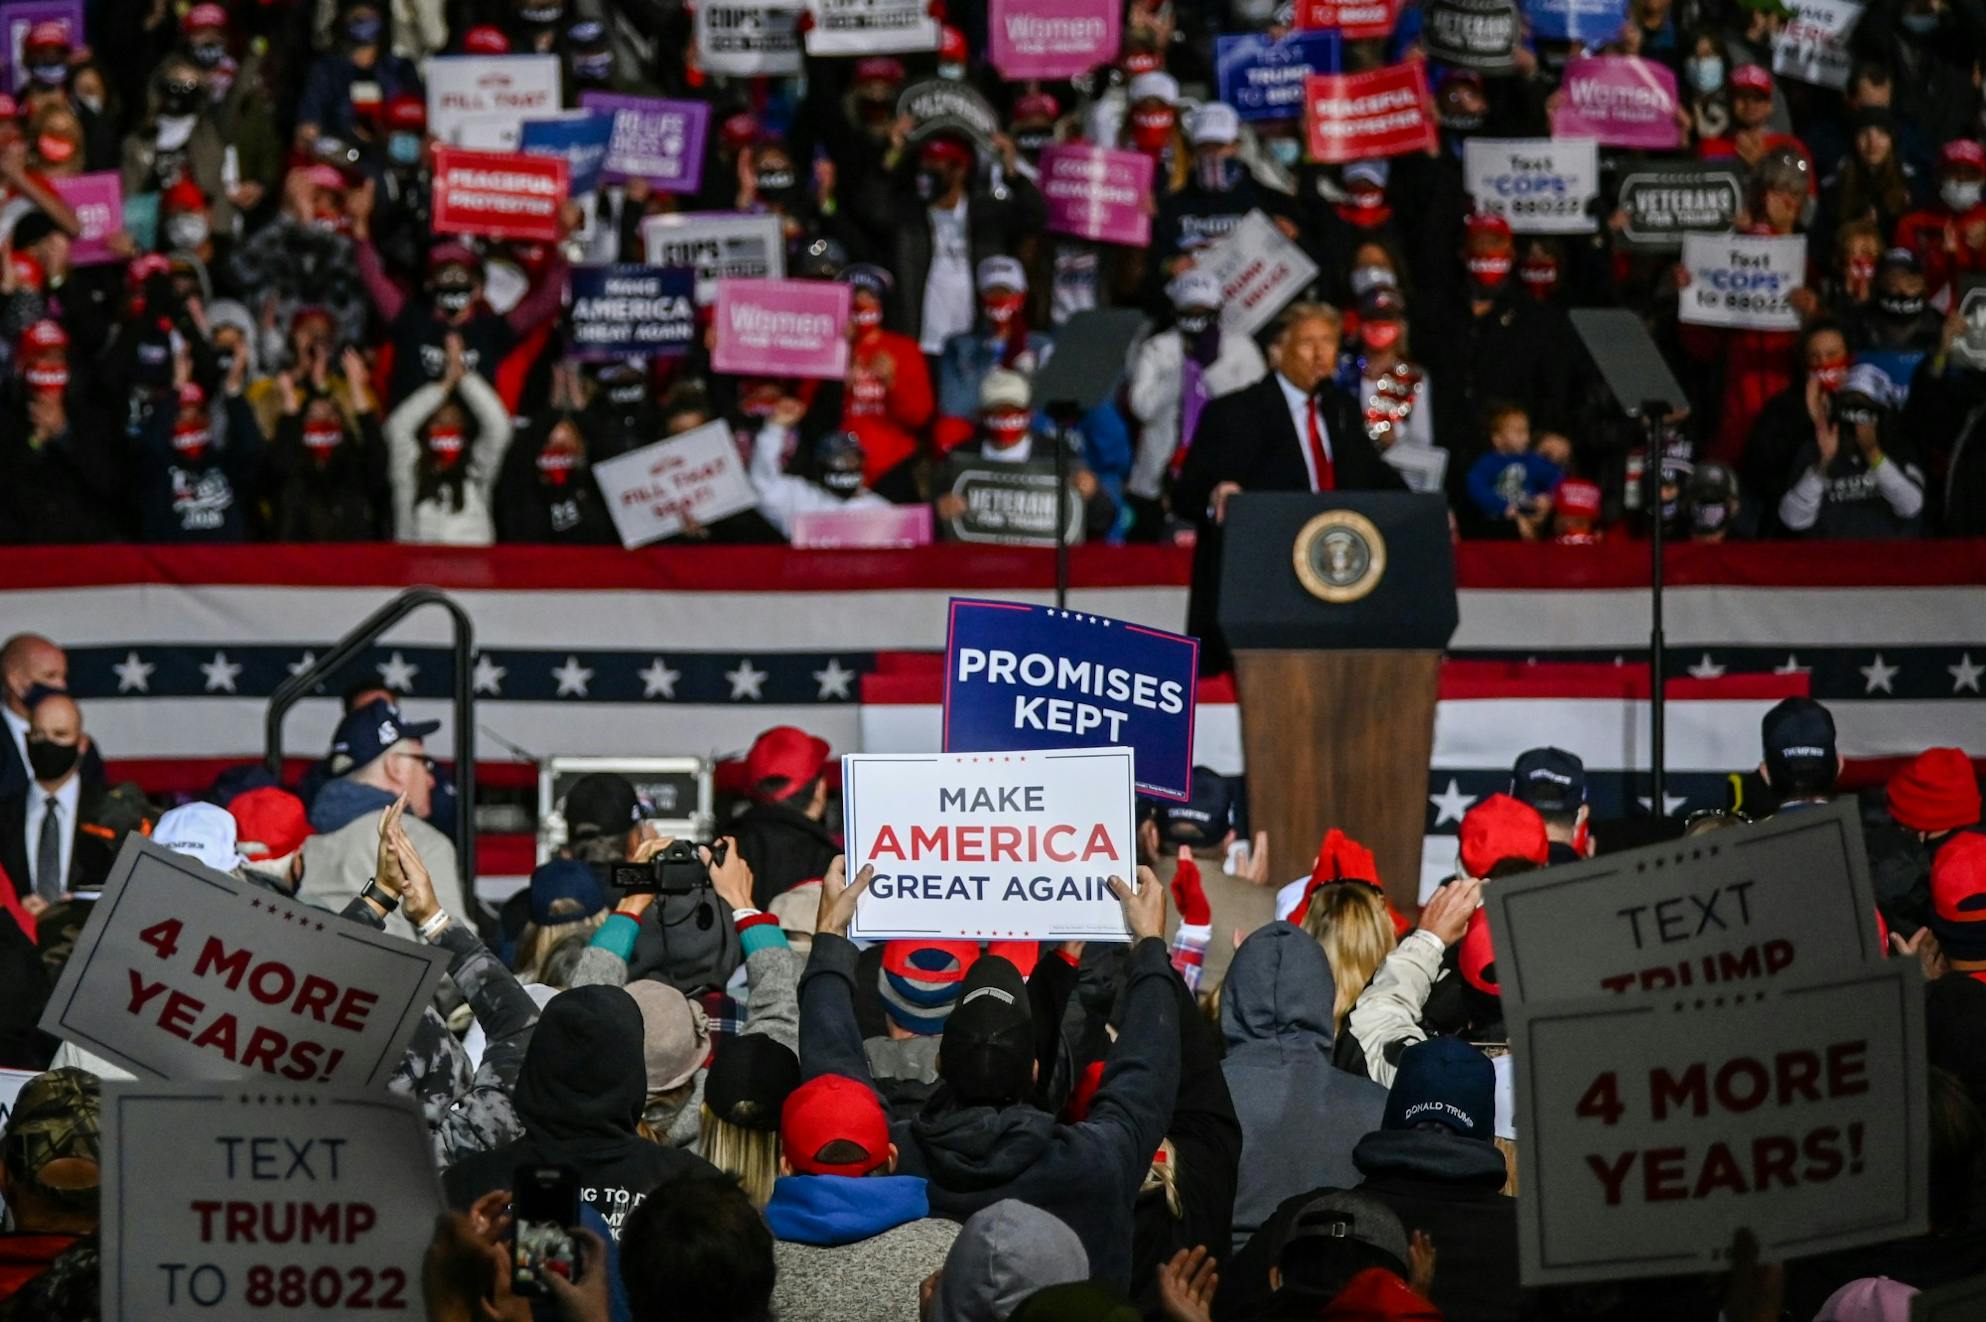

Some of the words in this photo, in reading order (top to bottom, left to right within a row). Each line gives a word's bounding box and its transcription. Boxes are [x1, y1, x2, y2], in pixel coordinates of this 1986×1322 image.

[1005, 15, 1107, 40] Women
[1569, 78, 1672, 113] Women
[448, 168, 557, 194] PEACEFUL
[448, 190, 553, 216] PROTESTER
[1635, 188, 1733, 213] VETERANS
[572, 296, 694, 322] AMERICA
[731, 303, 834, 336] Women
[967, 488, 1057, 514] VETERAN
[958, 648, 1184, 715] PROMISES
[1014, 695, 1128, 742] KEPT
[939, 786, 1045, 812] MAKE
[868, 823, 1119, 862] AMERICA
[868, 874, 990, 901] GREAT
[1002, 876, 1121, 901] AGAIN
[1617, 880, 1754, 949] TEXT
[140, 918, 183, 959] 4
[193, 935, 379, 1033] MORE
[127, 969, 345, 1083] YEARS!
[1576, 1071, 1624, 1125] 4
[1649, 1039, 1869, 1122] MORE
[1405, 1101, 1444, 1120] DONALD
[1445, 1104, 1474, 1128] TRUMP
[216, 1136, 347, 1180] TEXT
[1586, 1122, 1865, 1204] YEARS!
[604, 1187, 630, 1203] TO
[190, 1201, 377, 1244] TRUMP
[159, 1263, 227, 1306] TO
[245, 1266, 407, 1309] 88022
